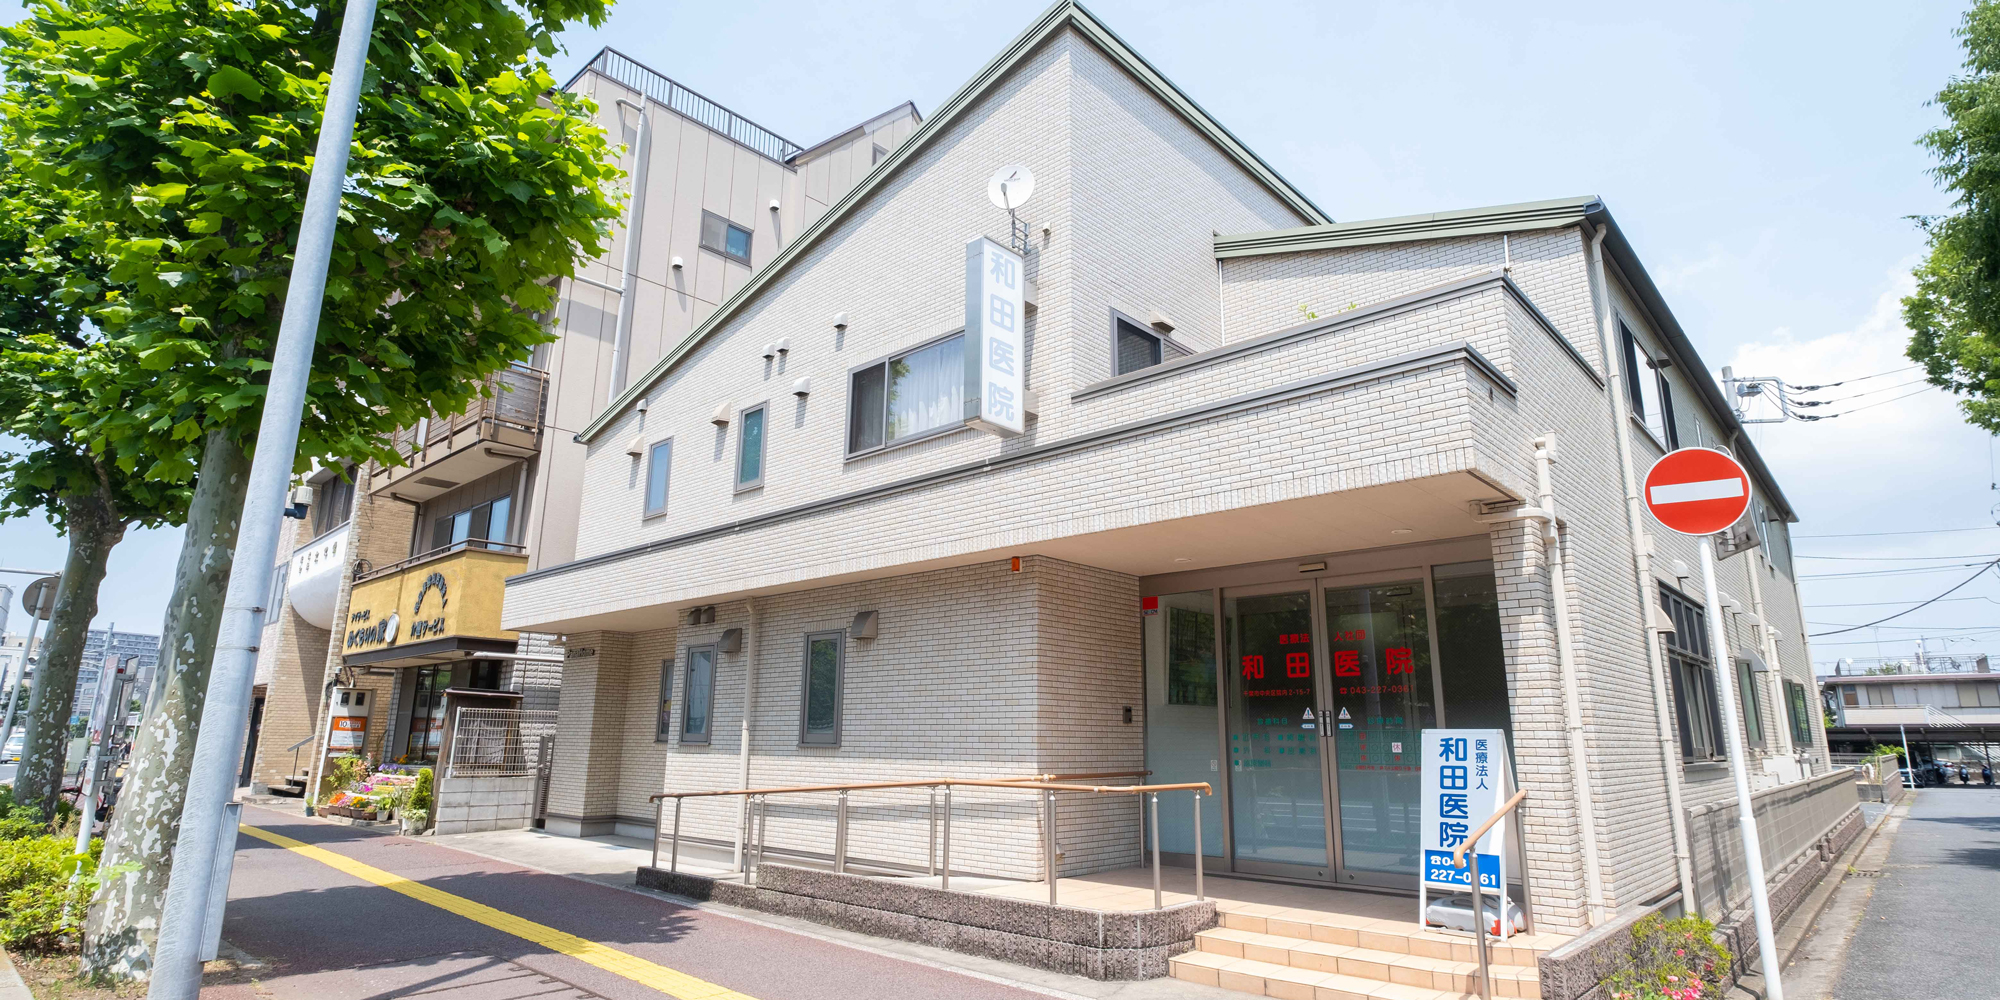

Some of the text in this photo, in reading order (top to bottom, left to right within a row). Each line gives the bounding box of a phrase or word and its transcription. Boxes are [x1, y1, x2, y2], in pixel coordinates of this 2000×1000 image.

[987, 251, 1015, 422] 和田医院
[1439, 737, 1468, 848] 和田医院
[1475, 739, 1488, 790] 医療法人
[1430, 868, 1496, 886] 227-061
